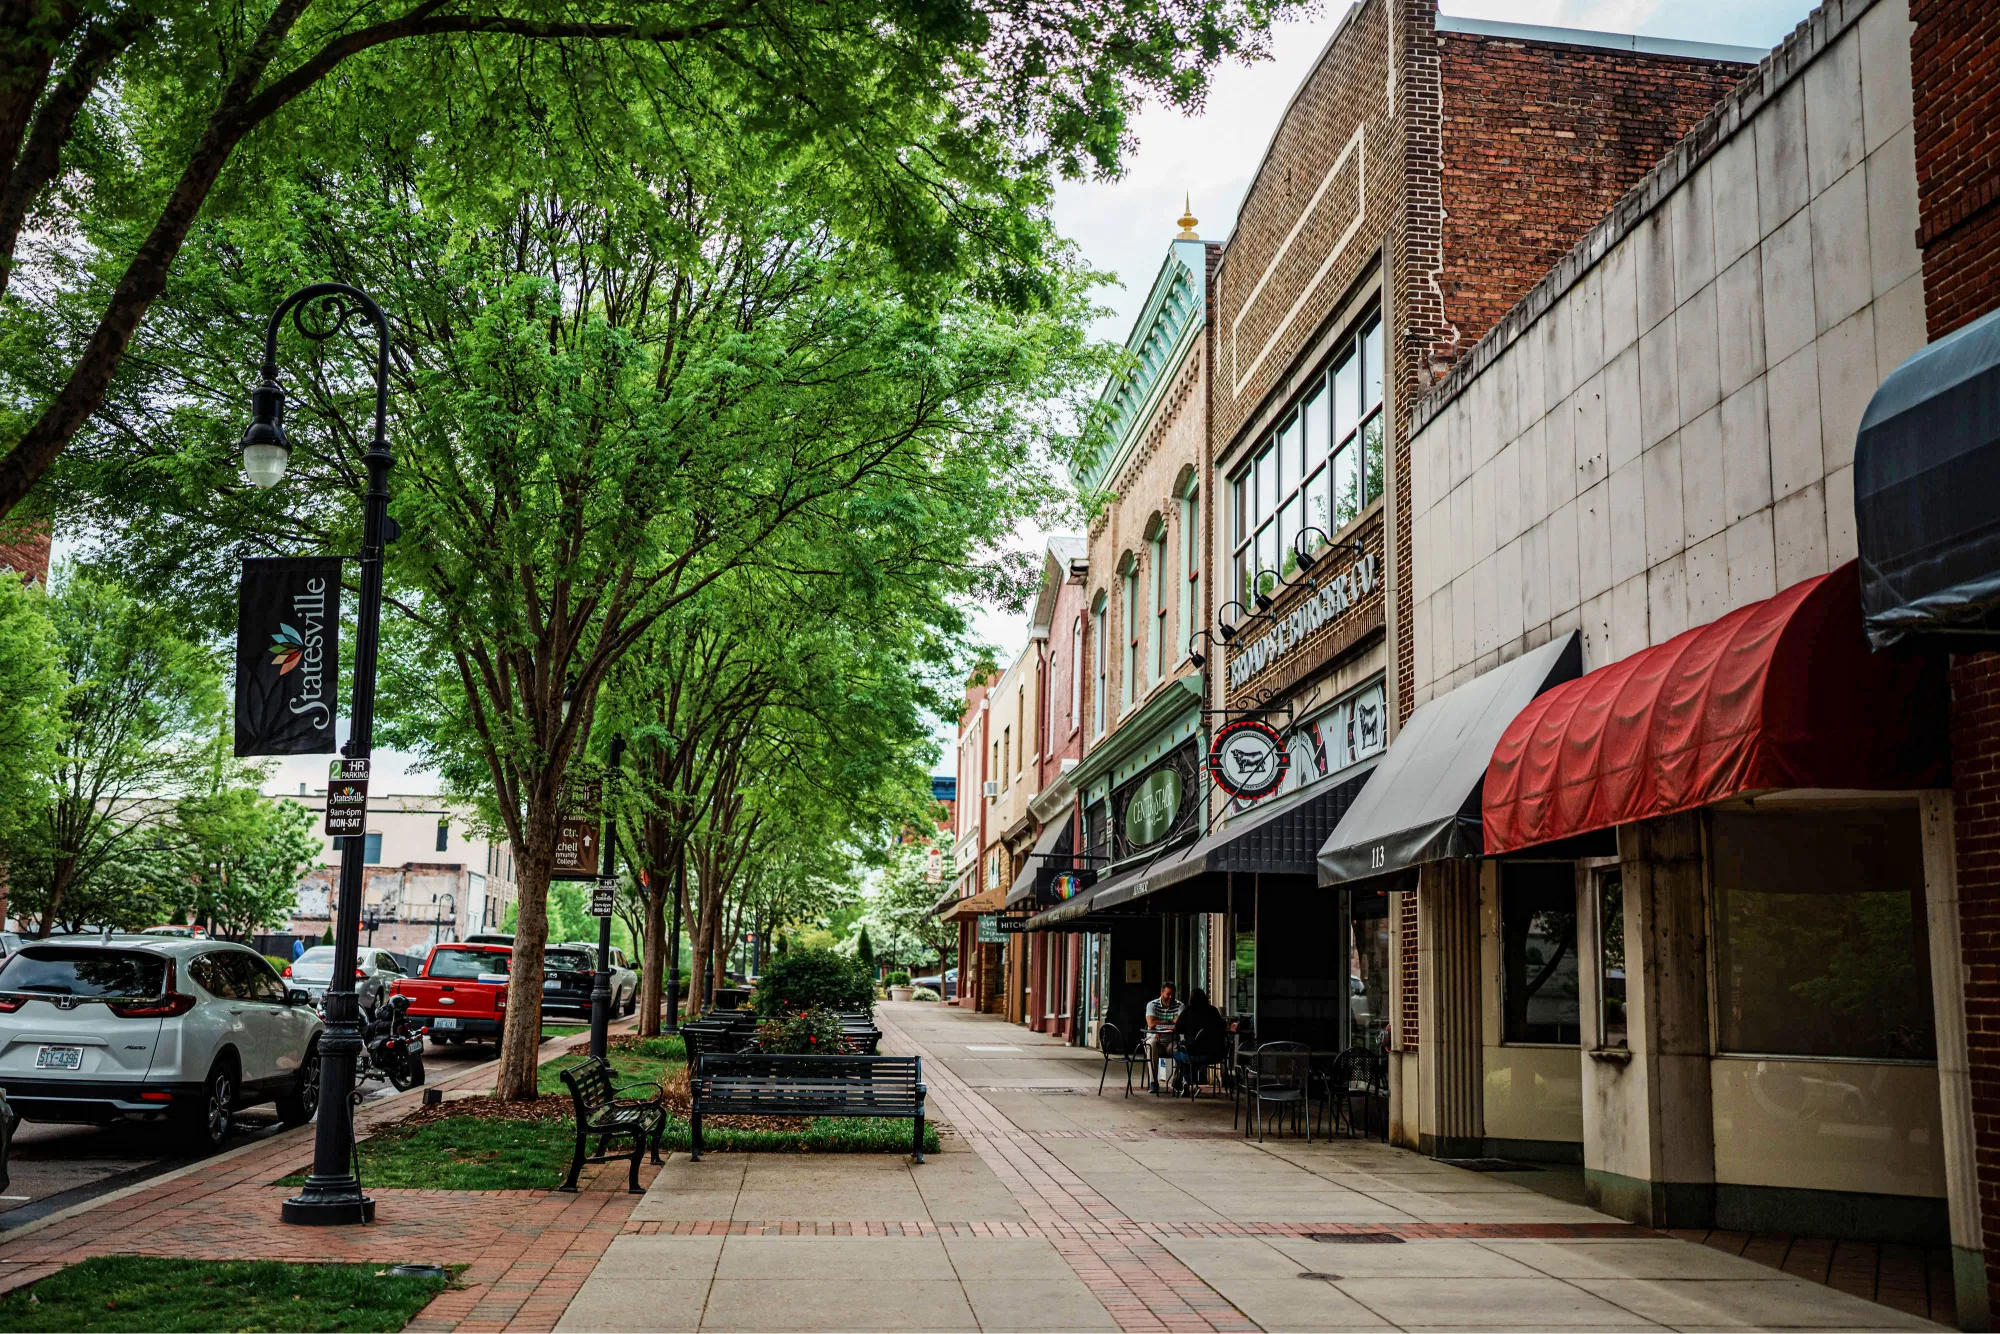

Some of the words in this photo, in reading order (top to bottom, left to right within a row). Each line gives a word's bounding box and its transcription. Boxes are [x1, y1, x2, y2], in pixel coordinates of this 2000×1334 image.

[1231, 637, 1269, 691] BROAD
[1269, 621, 1288, 662] ST.
[1289, 574, 1349, 647] BURGER
[1351, 554, 1379, 601] CO.
[289, 577, 330, 730] Statesville
[330, 761, 340, 778] 2
[350, 761, 365, 771] HR
[341, 771, 368, 779] PARKING
[329, 791, 365, 804] Statesville
[330, 808, 361, 817] 9am-6pm
[1133, 794, 1154, 824] CENTER
[329, 818, 361, 828] MON-SAT
[1371, 845, 1385, 868] 113
[39, 1052, 79, 1064] STY-4396
